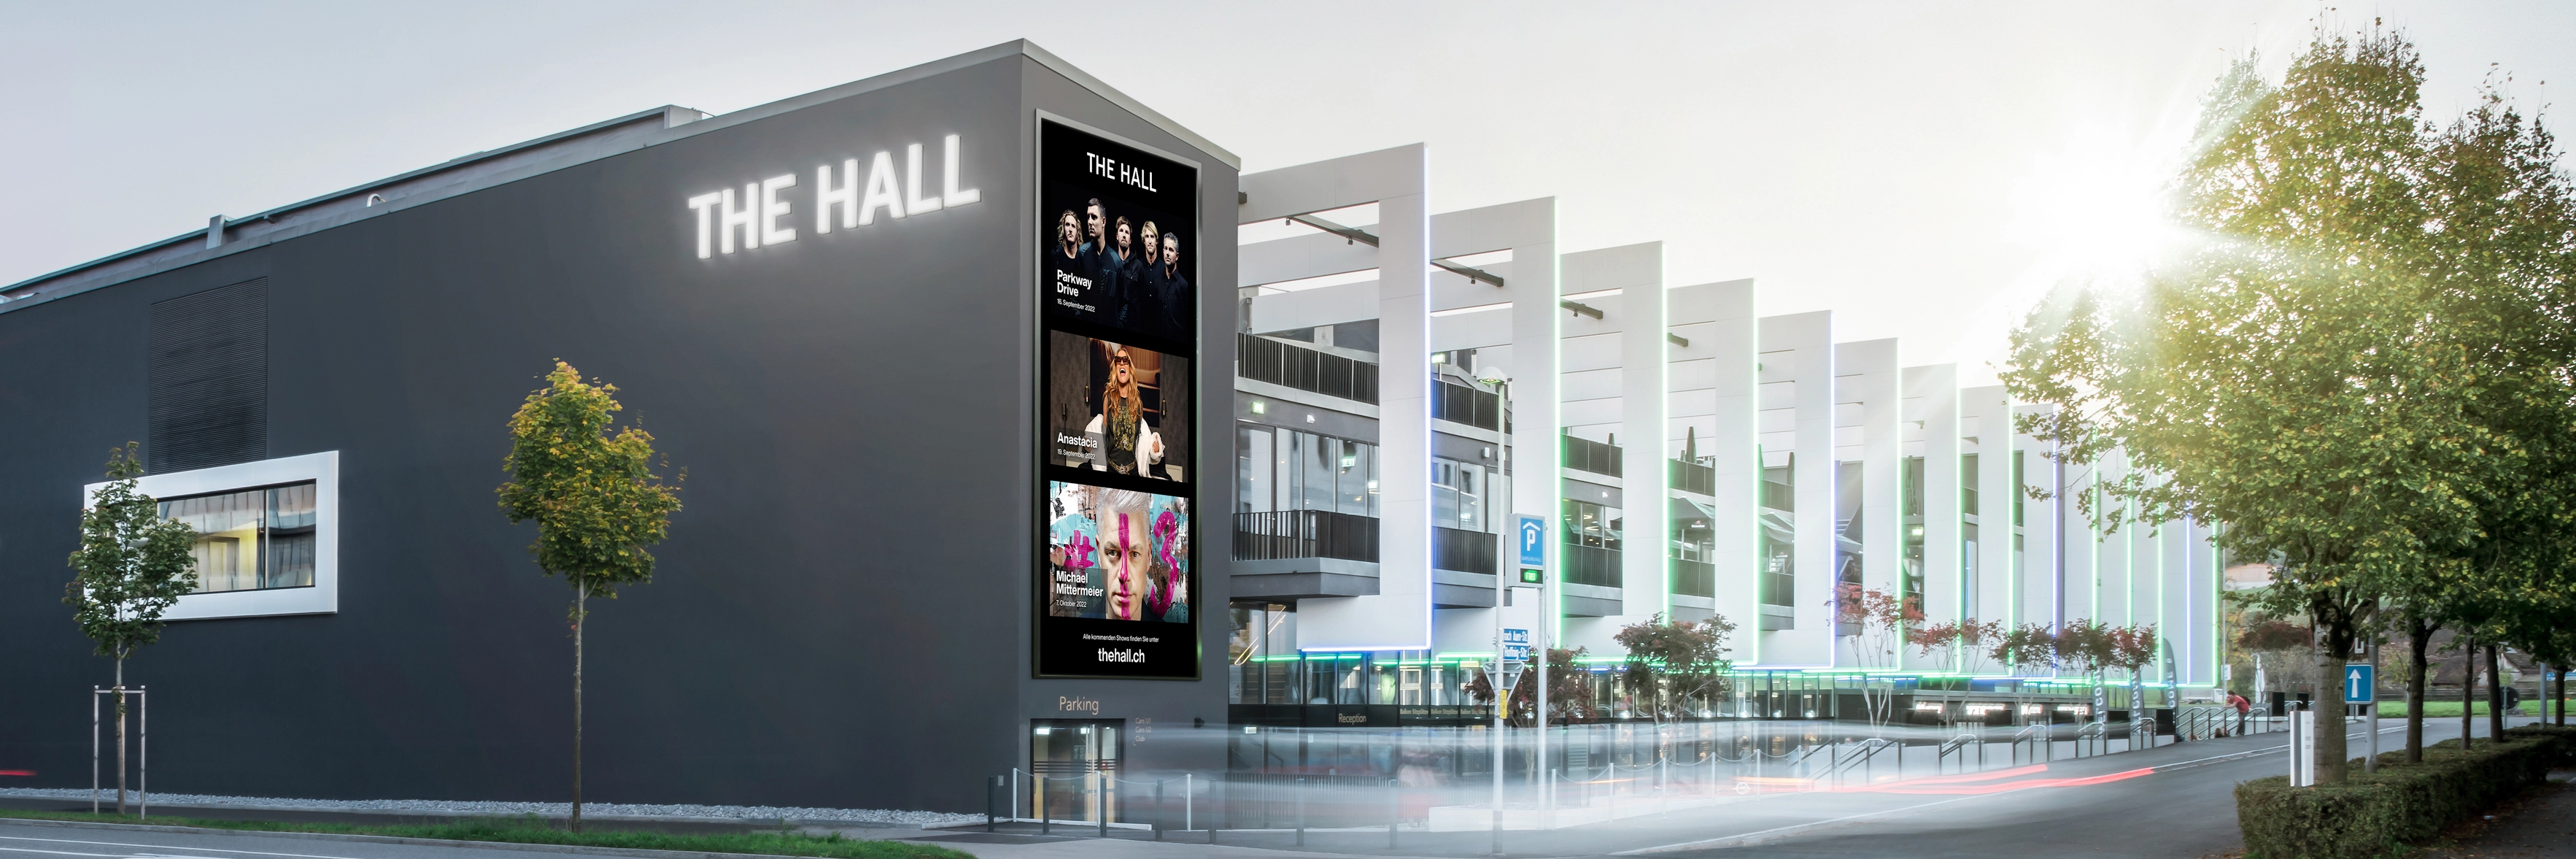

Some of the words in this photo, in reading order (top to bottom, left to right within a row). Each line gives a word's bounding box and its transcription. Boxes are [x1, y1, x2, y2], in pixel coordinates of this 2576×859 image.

[1086, 152, 1115, 180] THE
[1121, 162, 1157, 193] HALL
[689, 174, 797, 259] THE
[817, 134, 981, 235] HALL
[1056, 269, 1093, 290] Parkway
[1056, 281, 1079, 297] Drive
[1063, 299, 1085, 310] September
[1085, 304, 1096, 312] 2022
[1057, 431, 1098, 449] Anastacia
[1063, 449, 1085, 458] September
[1085, 452, 1096, 460] 2022
[1526, 529, 1536, 552] P
[1056, 570, 1088, 584] Michael
[1056, 583, 1104, 597] Mittermeier
[1097, 647, 1145, 663] thehall.ch
[1059, 696, 1099, 716] Parking
[1339, 713, 1366, 725] Reception
